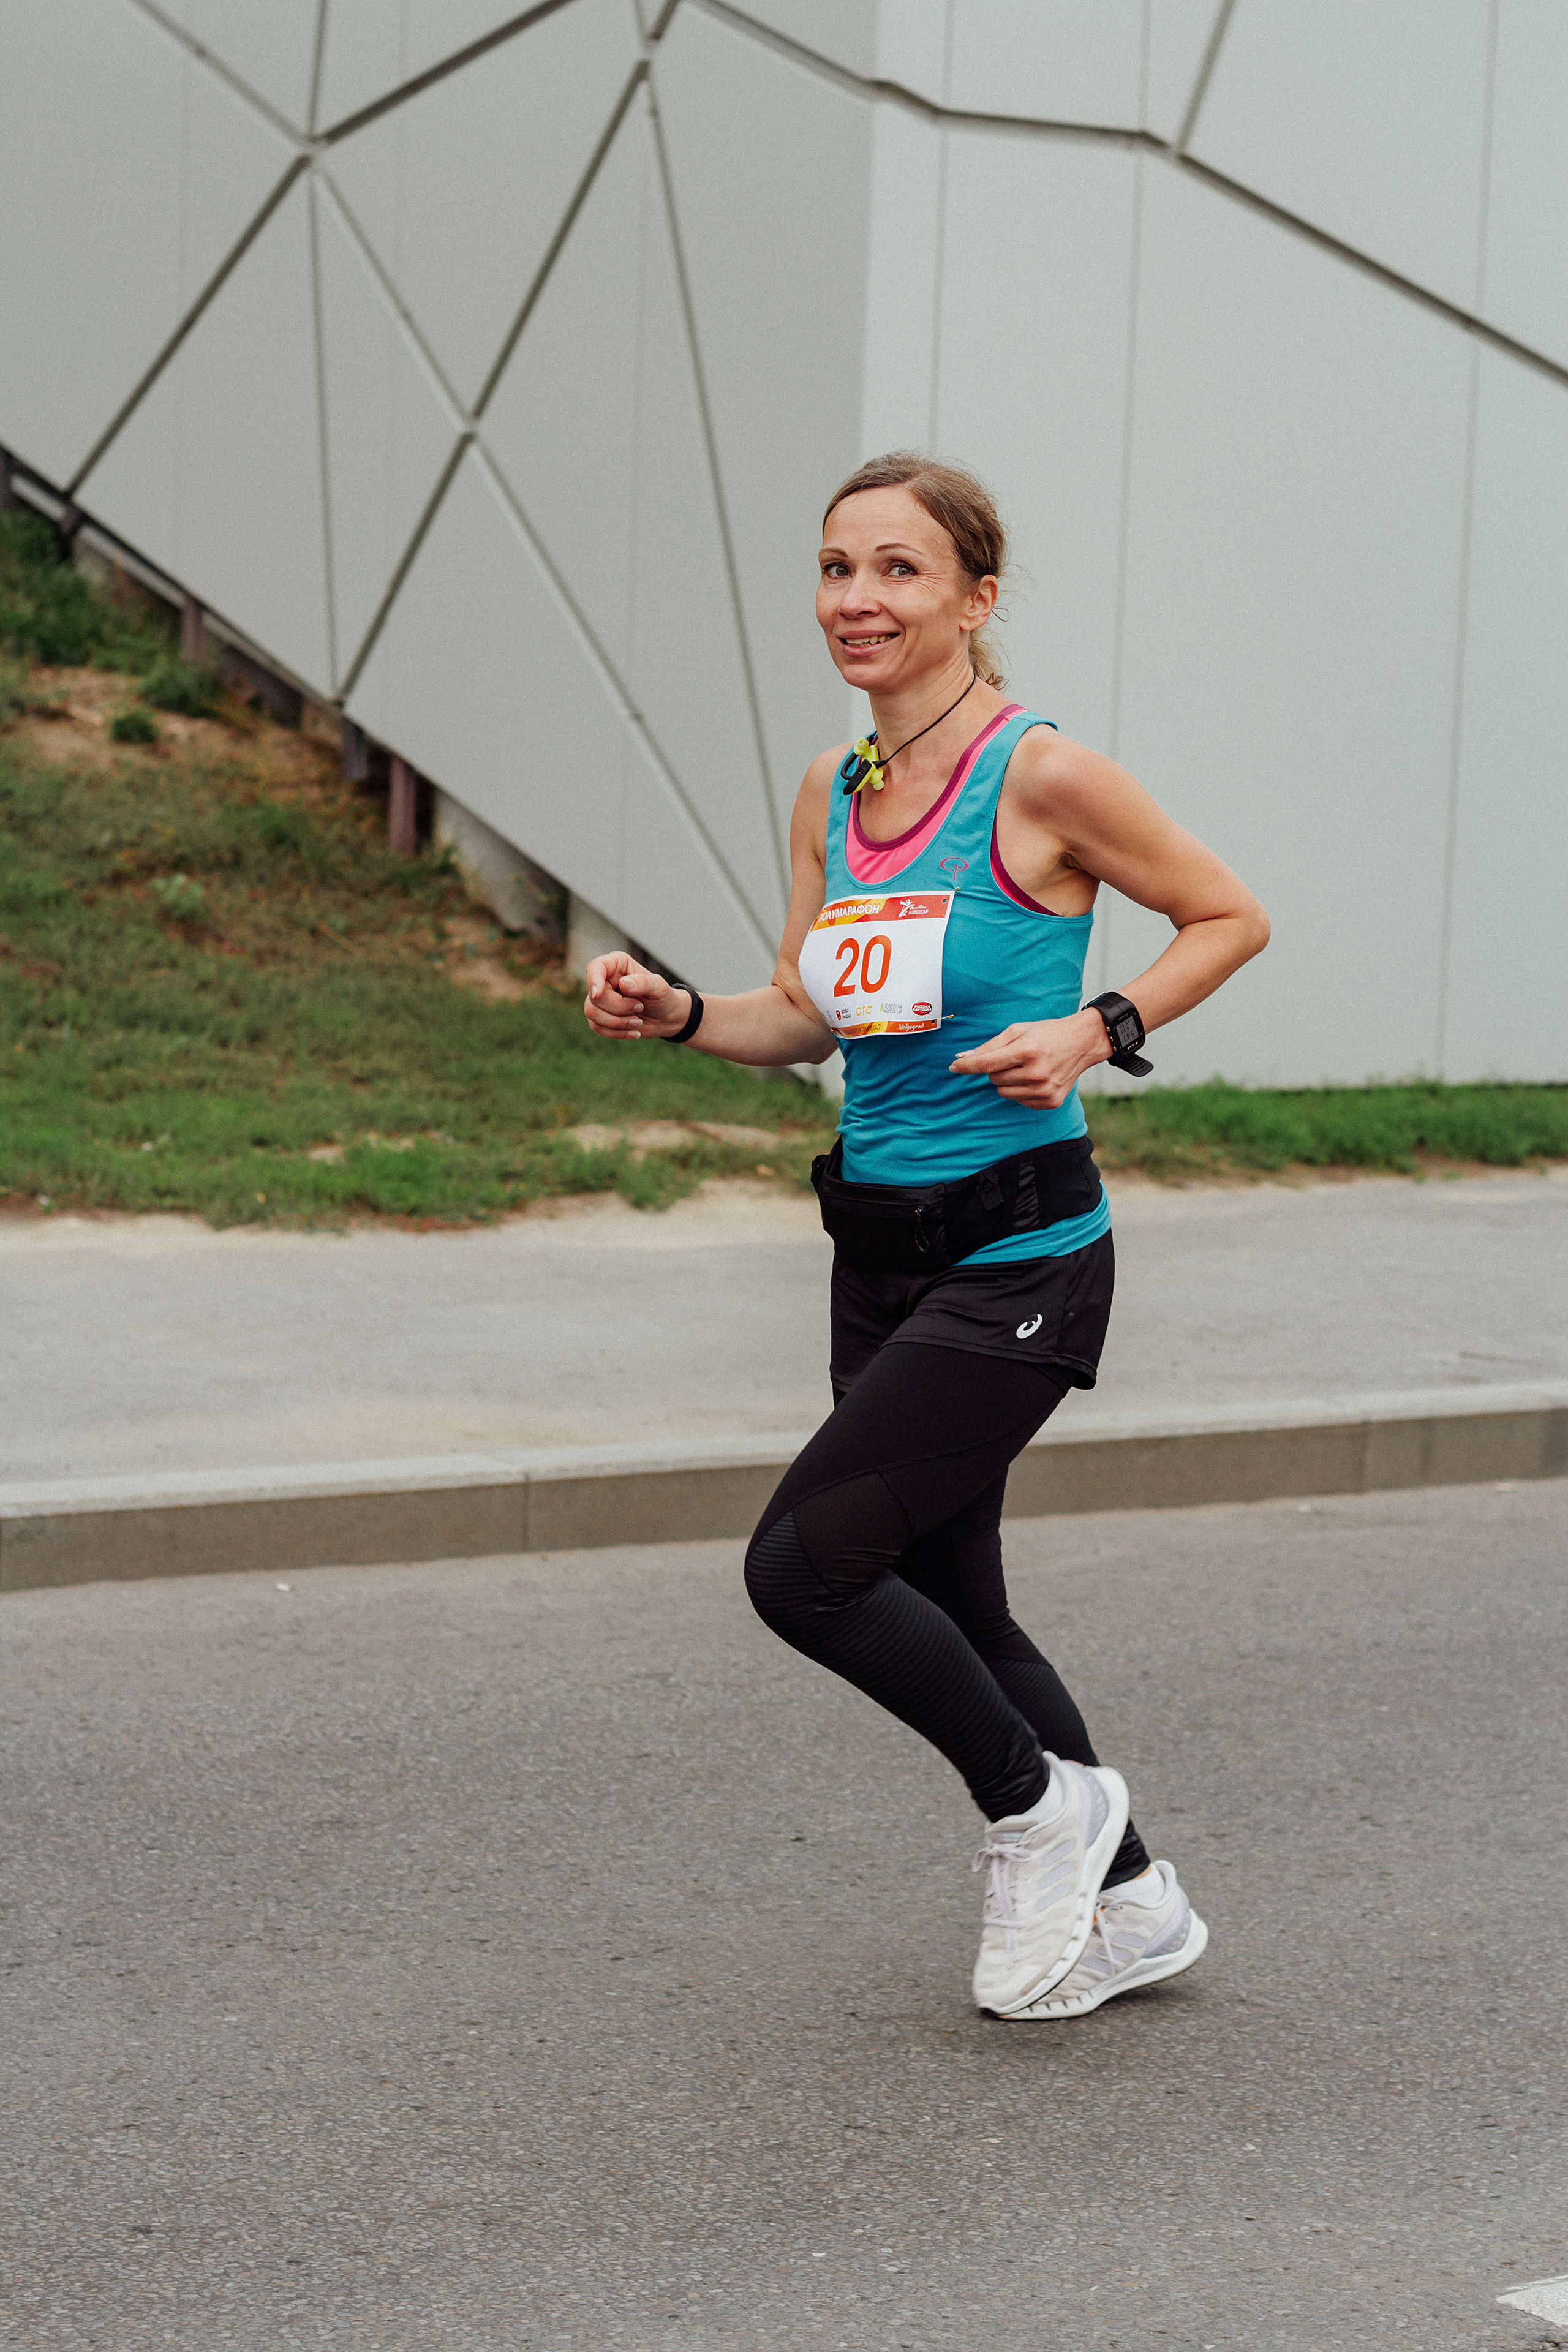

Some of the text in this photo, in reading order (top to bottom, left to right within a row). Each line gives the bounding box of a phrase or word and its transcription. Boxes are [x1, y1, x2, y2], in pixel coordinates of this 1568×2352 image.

[818, 904, 880, 922] ПОЛУМАРАФОН
[834, 935, 892, 997] 20
[899, 1022, 924, 1031] Volgograd
